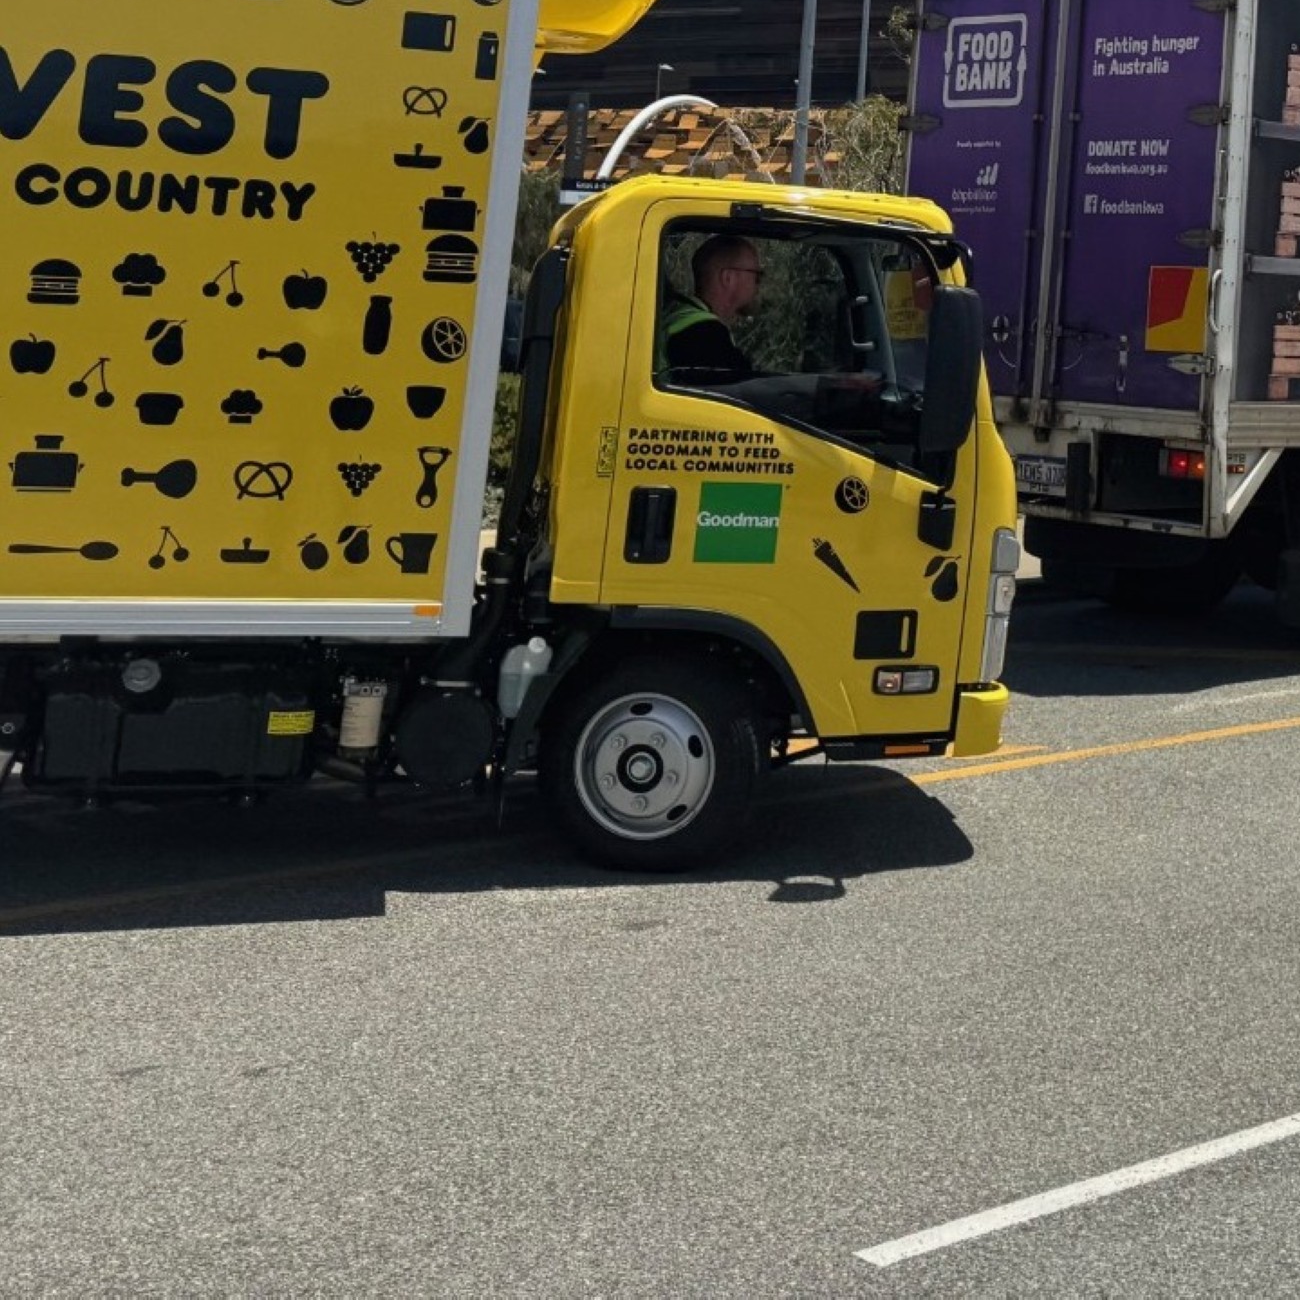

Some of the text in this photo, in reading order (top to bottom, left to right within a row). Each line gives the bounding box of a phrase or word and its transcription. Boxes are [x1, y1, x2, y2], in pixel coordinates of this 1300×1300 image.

[958, 31, 1014, 61] FOOD
[1095, 34, 1200, 57] Fighting hunger
[955, 61, 1012, 91] BANK
[1093, 57, 1170, 76] in Australia
[1088, 139, 1170, 157] DONATE NOW
[15, 163, 316, 222] COUNTRY
[1100, 199, 1164, 214] foodbankwa
[628, 428, 774, 445] PARTNERING WITH
[626, 443, 781, 460] GOODMAN TO FEED
[624, 458, 795, 475] LOCAL COMMUNITIES
[697, 510, 780, 529] Goodman
